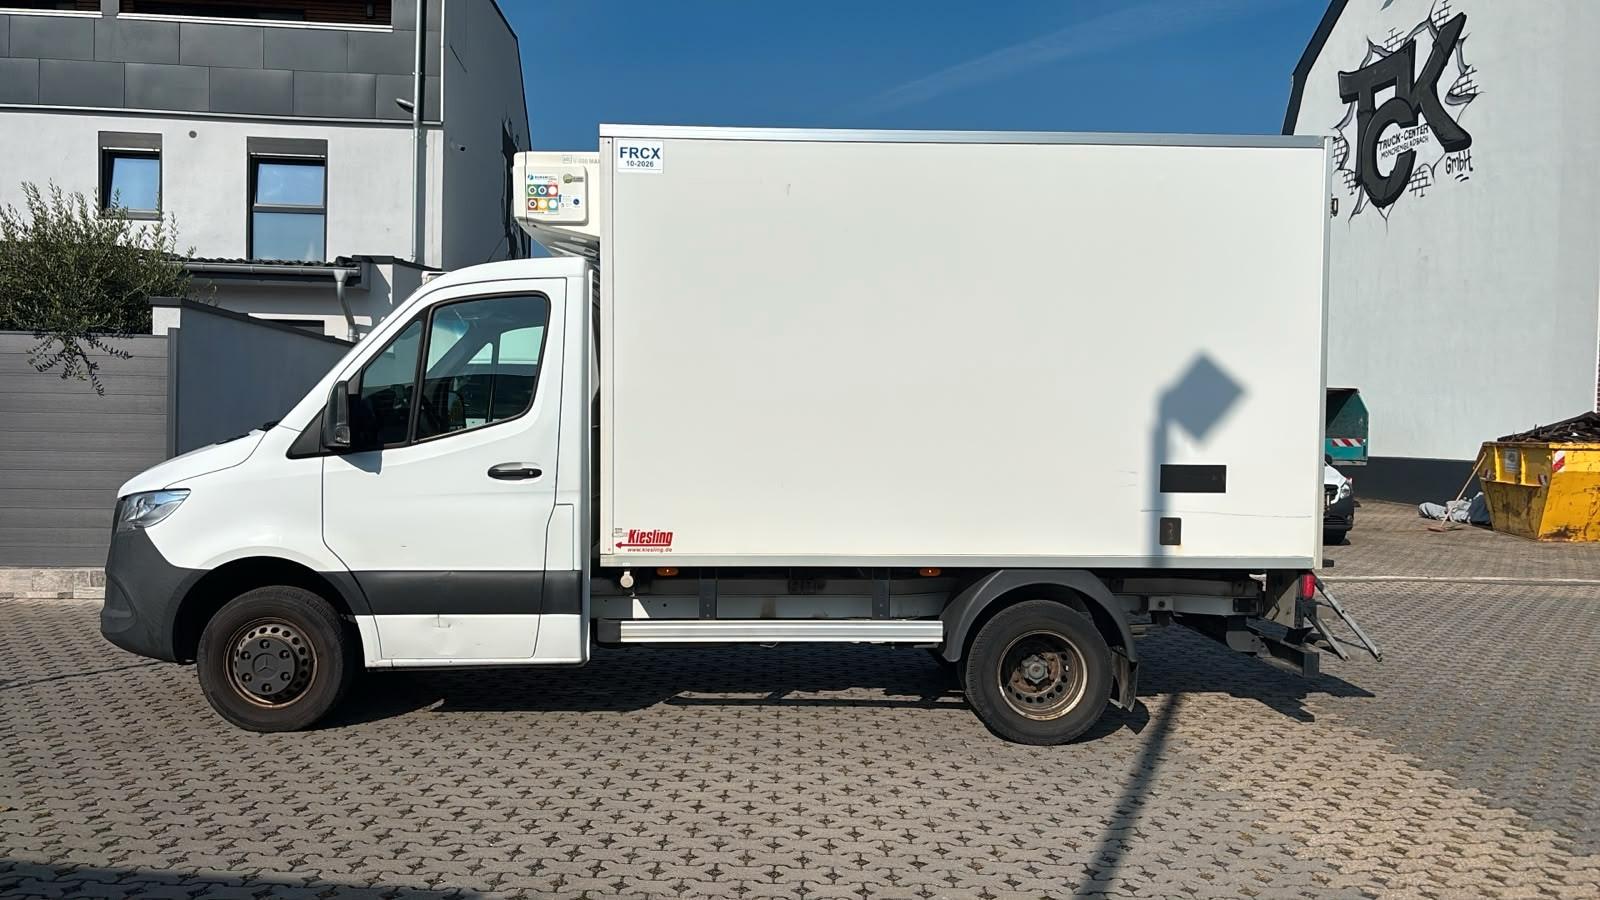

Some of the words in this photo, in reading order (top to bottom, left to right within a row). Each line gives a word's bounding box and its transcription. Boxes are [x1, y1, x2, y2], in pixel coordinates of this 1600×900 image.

[1338, 11, 1472, 209] TCK
[1378, 124, 1429, 150] TRUCK-CENTER
[620, 147, 660, 159] FRCX
[1446, 150, 1473, 174] GmbH
[626, 160, 654, 168] 10-2026
[628, 529, 673, 545] Kiesling
